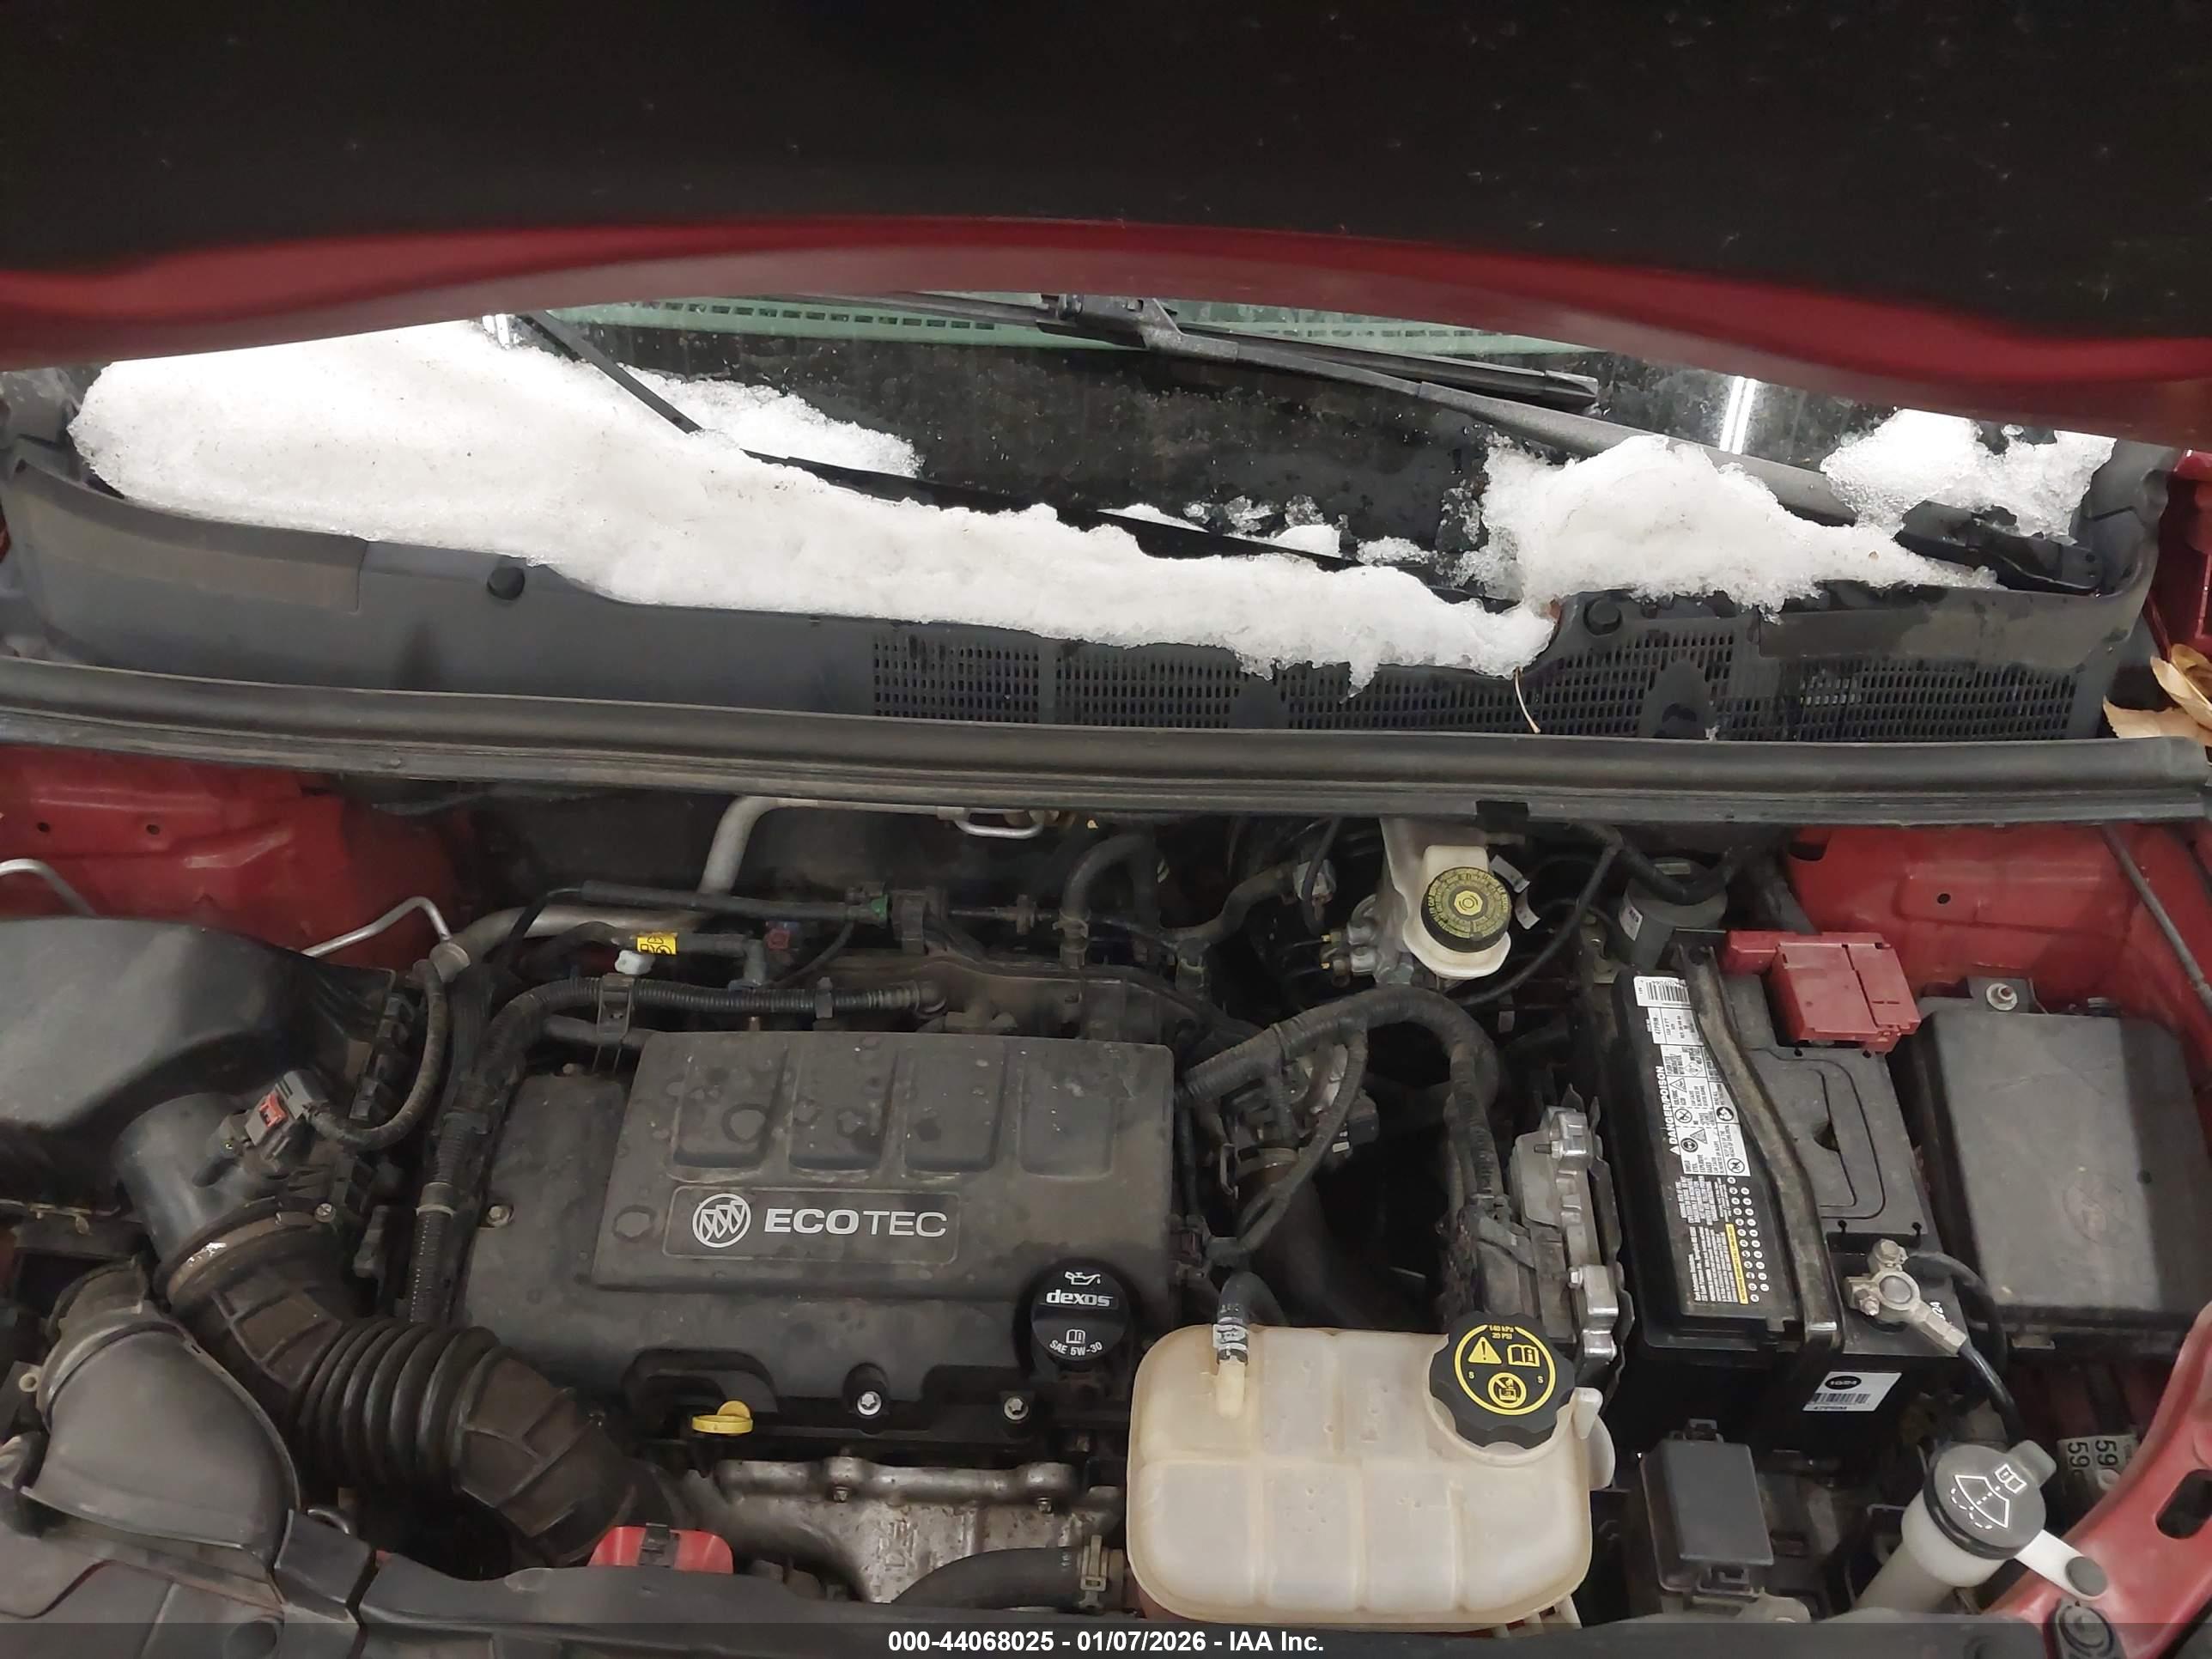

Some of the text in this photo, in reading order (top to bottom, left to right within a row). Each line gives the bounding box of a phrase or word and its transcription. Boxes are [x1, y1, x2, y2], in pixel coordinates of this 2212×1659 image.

[1655, 1066, 1678, 1145] DANGER/POISON
[763, 1208, 948, 1237] ECOTEC
[1046, 1289, 1114, 1306] dexos
[1049, 1340, 1103, 1356] SAE 5W-30
